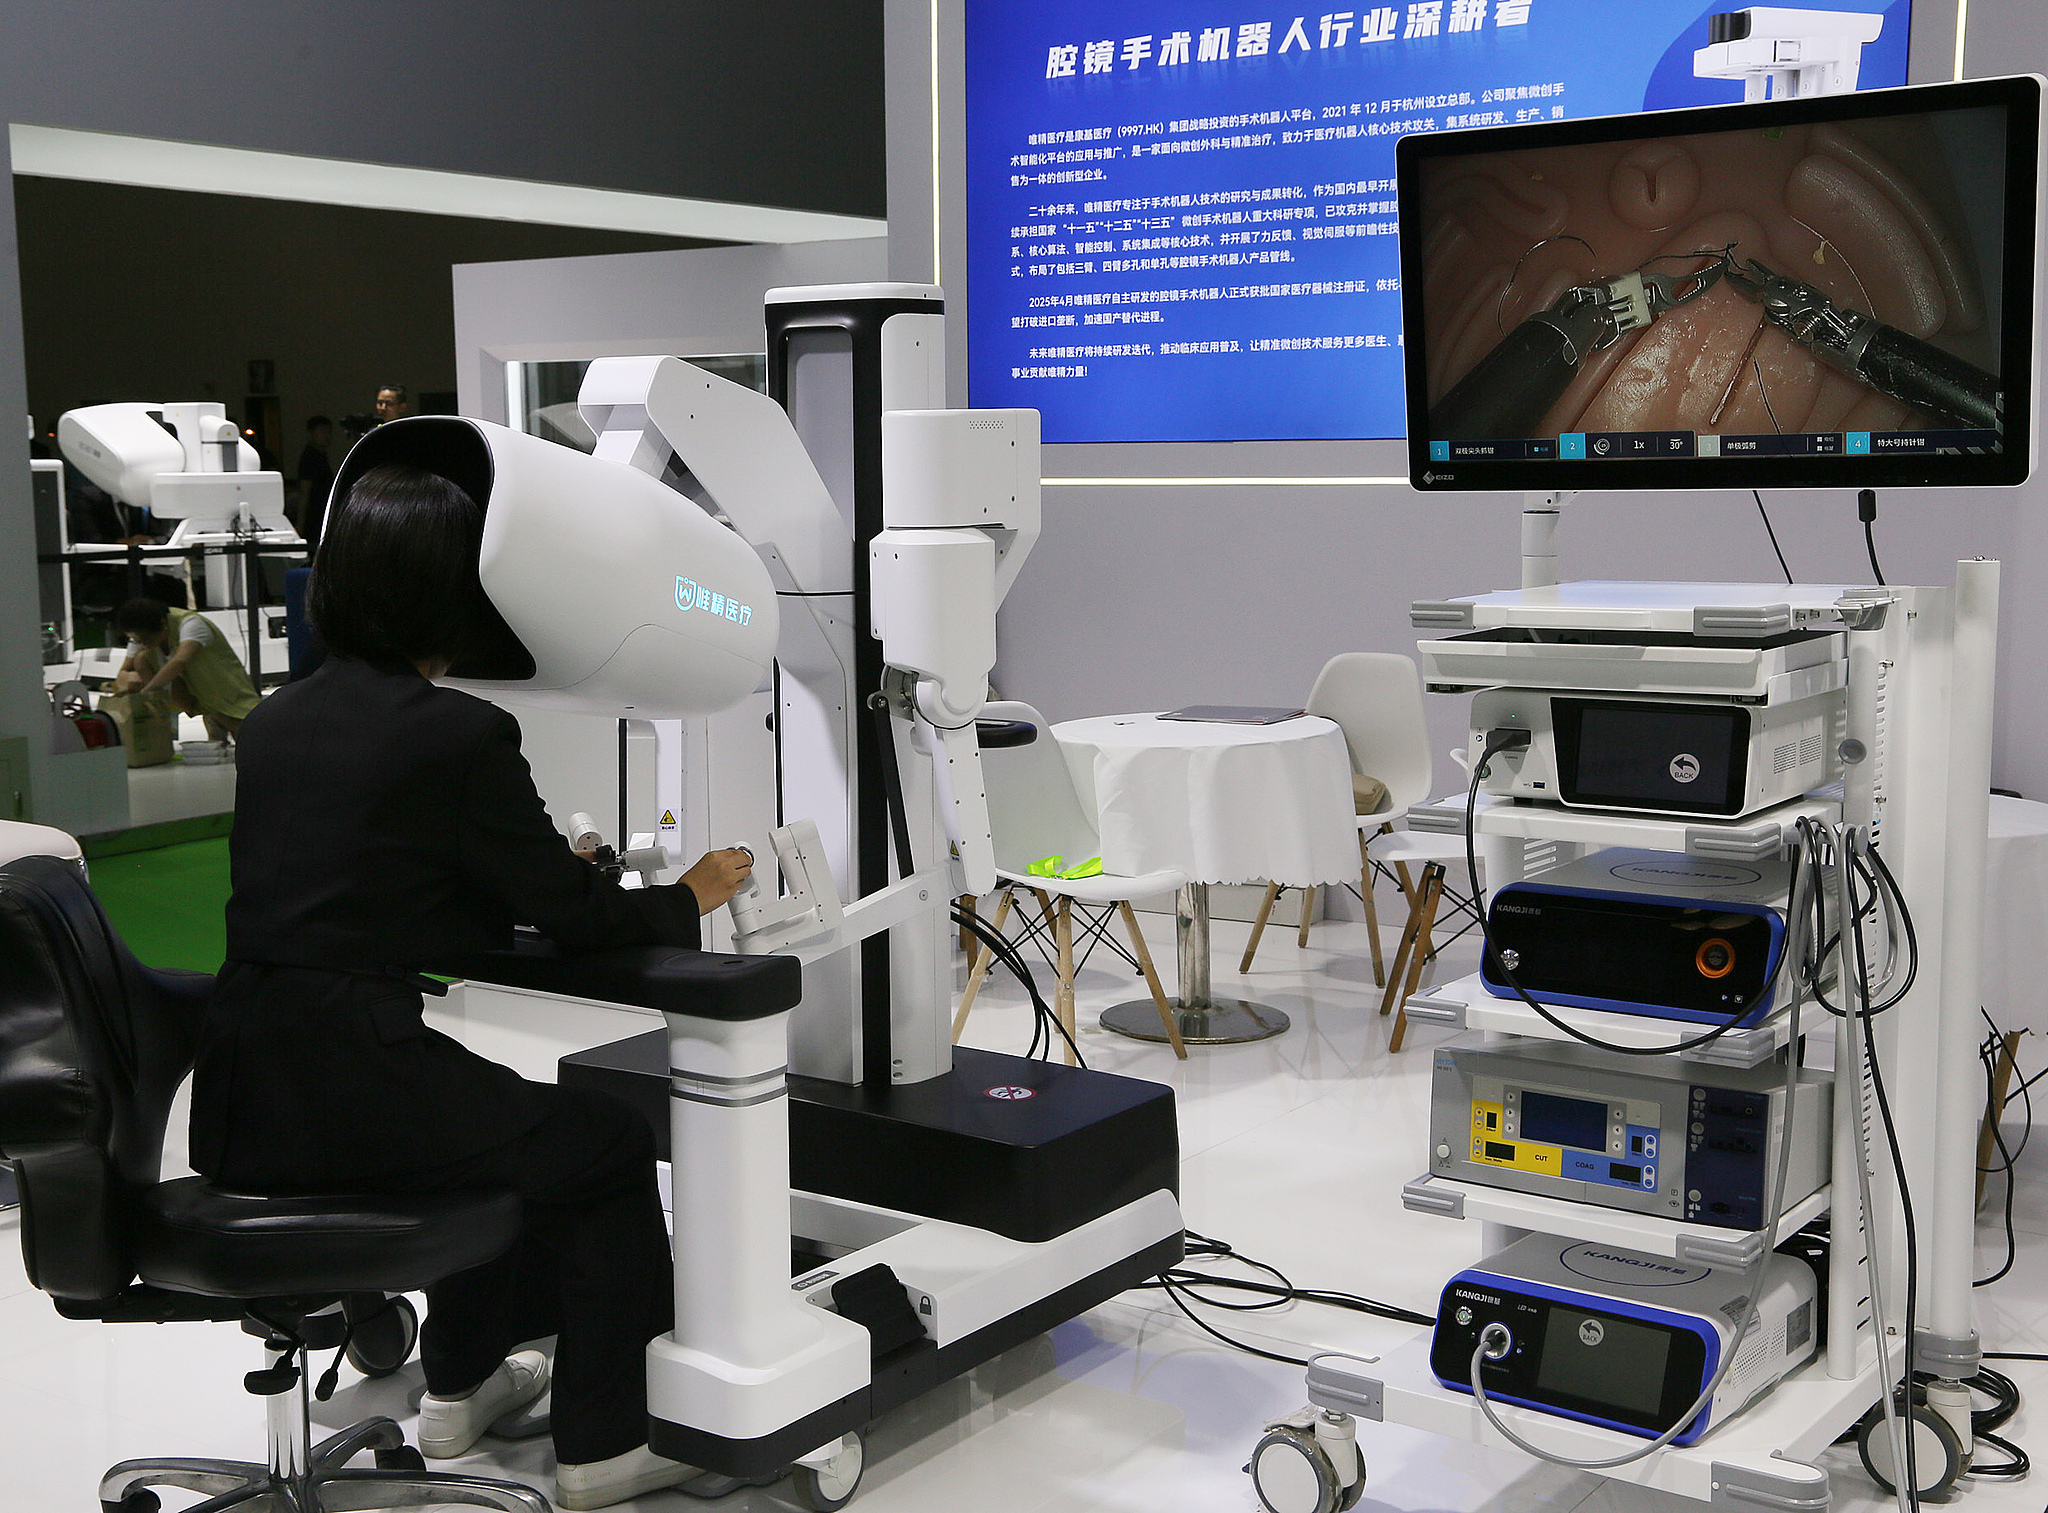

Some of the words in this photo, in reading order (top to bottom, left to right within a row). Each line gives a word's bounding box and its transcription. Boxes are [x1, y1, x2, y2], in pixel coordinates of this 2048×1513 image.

[1045, 0, 1533, 79] 腔镜手术机器人行业深耕者
[1010, 168, 1108, 187] 售为一体的创新型企业。
[1010, 249, 1296, 278] 式，布局了包括三臂、四臂多孔和单孔等腔镜手术机器人产品管线。
[1028, 278, 1401, 308] 2025年4月唯精医疗自主研发的腔镜手术机器人正式获批国家医疗器械注册证，依托
[1011, 310, 1165, 329] 望打破进口垄断，加速国产替代进程。
[1569, 442, 1576, 450] 2
[1633, 440, 1645, 449] 1x
[695, 585, 753, 627] 唯精医疗
[1674, 771, 1694, 779] BACK
[1534, 1154, 1548, 1162] CUT
[1575, 1161, 1595, 1170] COAG
